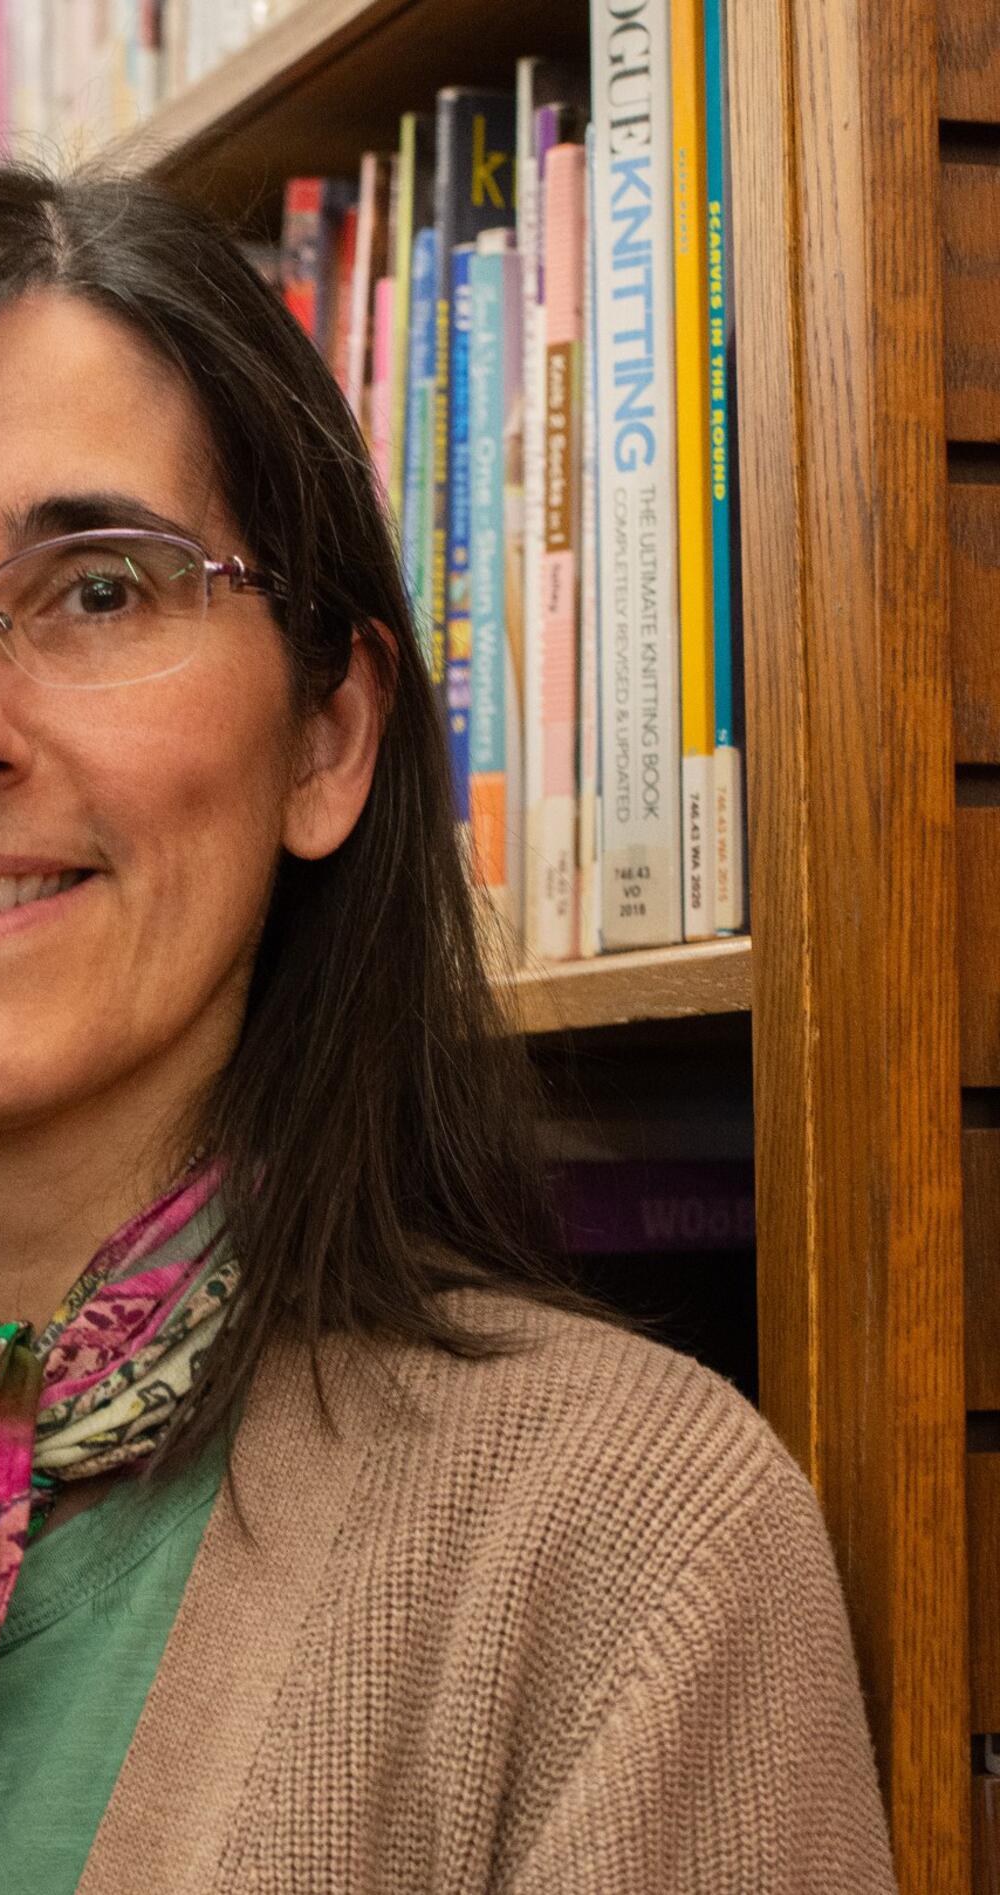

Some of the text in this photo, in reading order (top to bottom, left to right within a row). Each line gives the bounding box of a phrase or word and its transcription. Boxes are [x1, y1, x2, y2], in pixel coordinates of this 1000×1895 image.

[610, 156, 656, 473] KNITTING
[708, 201, 726, 500] SCARVES IN THE ROUND
[550, 433, 567, 508] Socks
[476, 622, 498, 764] Wonders
[613, 487, 630, 823] COMPLETELY REVISED & UPDATED
[639, 484, 660, 820] THE ULTIMATE KNITTING BOOK
[614, 866, 651, 881] 746.43
[623, 887, 641, 898] VO
[690, 792, 702, 910] 746.43 WA 2020
[718, 836, 728, 864] WA
